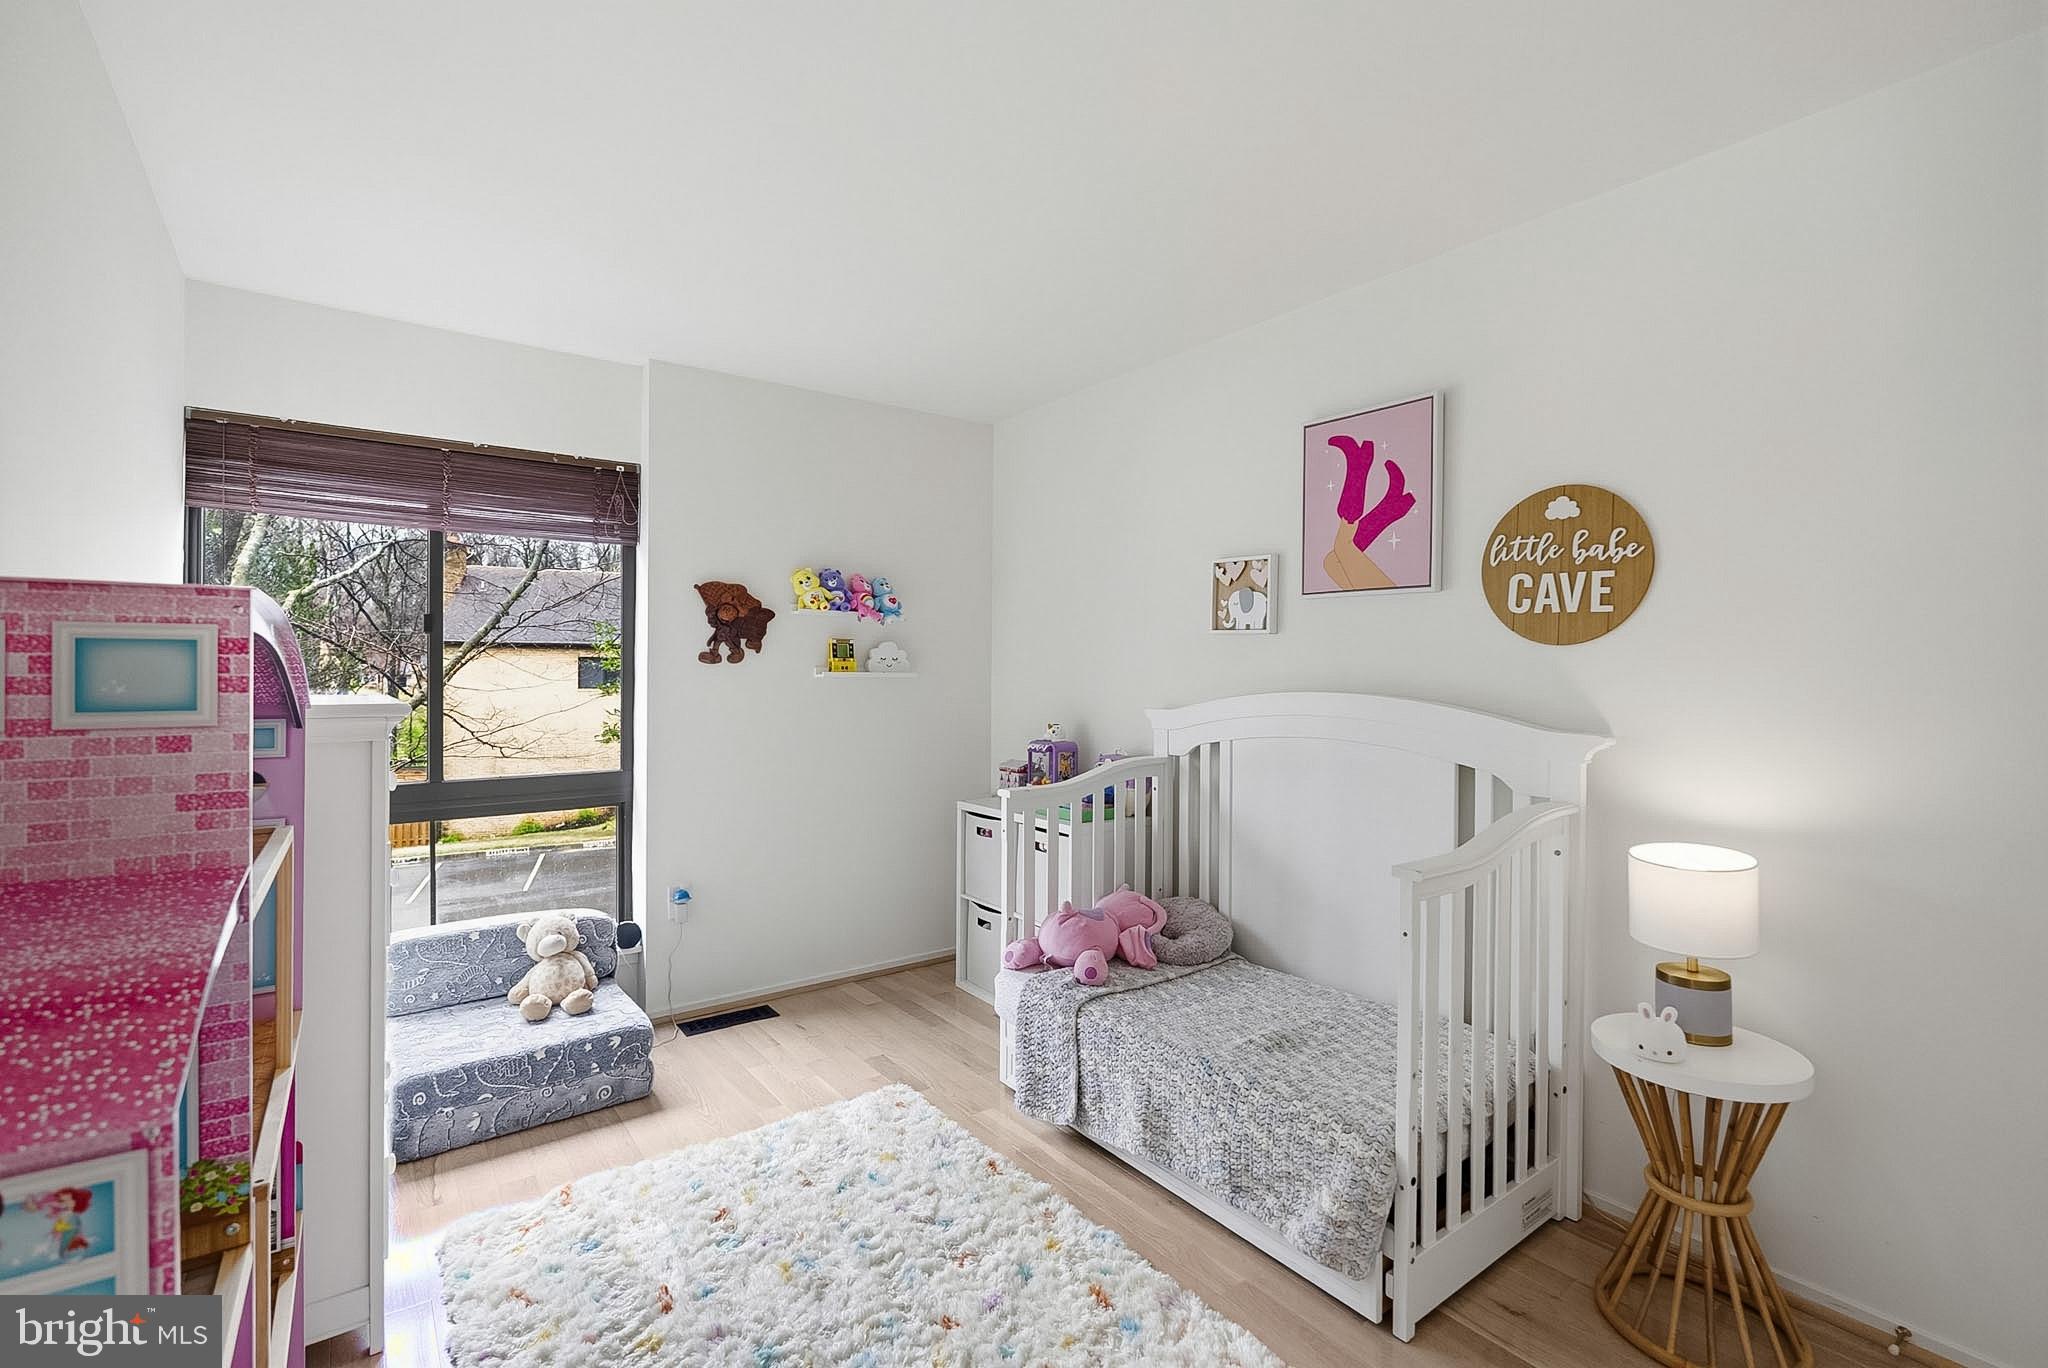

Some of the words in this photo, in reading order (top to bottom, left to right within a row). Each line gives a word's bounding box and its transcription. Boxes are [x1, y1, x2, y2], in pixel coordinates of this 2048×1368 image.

[1490, 533, 1564, 567] little
[1572, 527, 1645, 565] babe
[1508, 569, 1616, 614] CAVE
